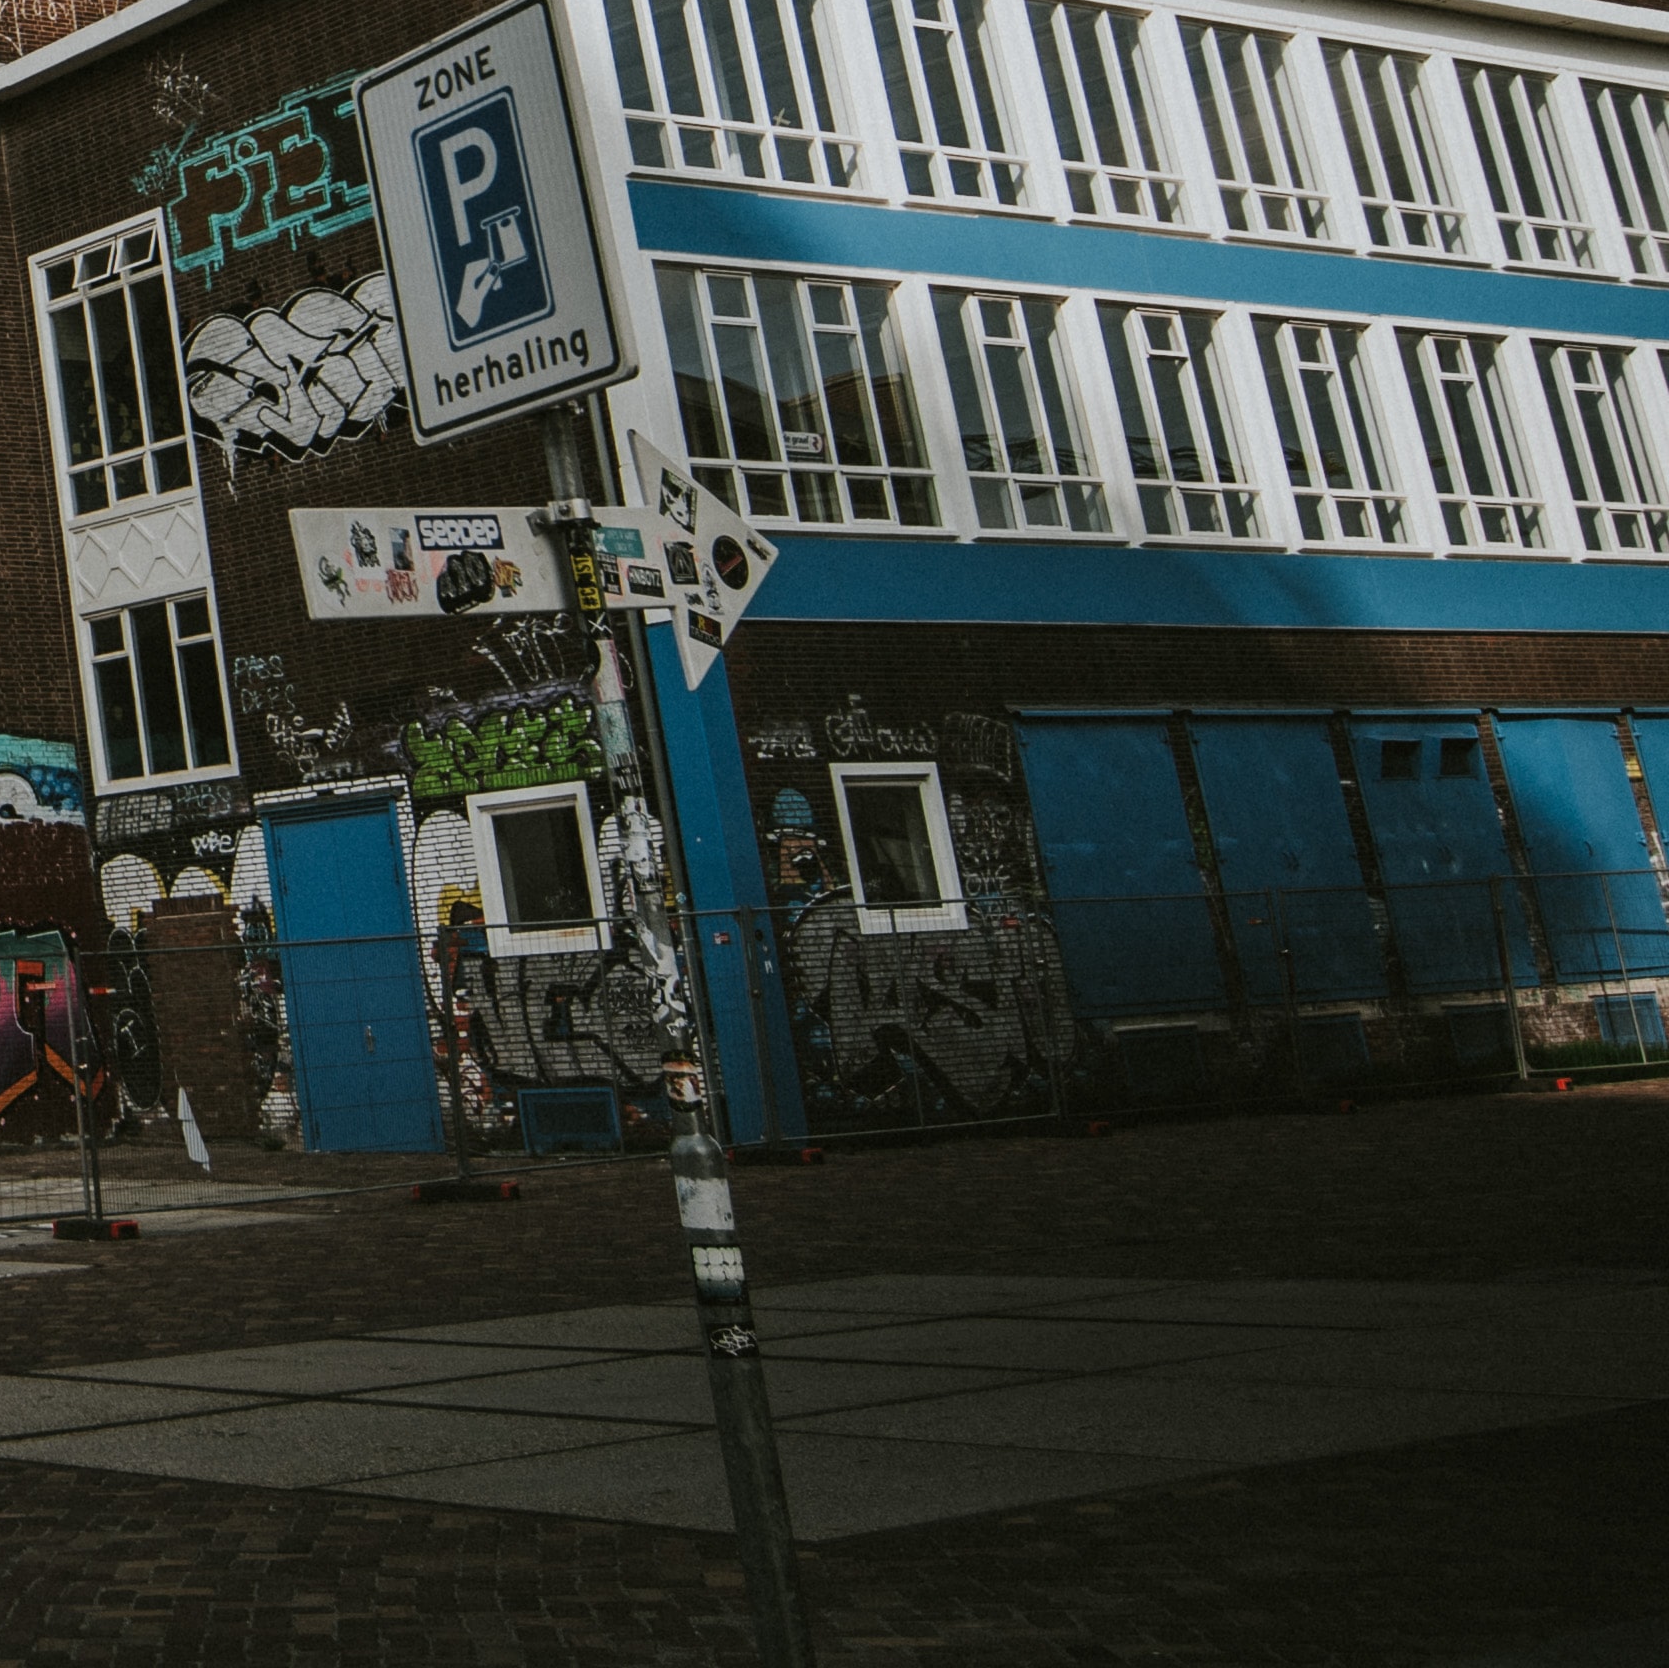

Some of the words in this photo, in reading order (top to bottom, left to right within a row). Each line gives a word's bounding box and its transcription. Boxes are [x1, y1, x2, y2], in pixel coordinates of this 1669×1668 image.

[413, 45, 496, 112] ZONE
[439, 125, 498, 247] P
[432, 328, 590, 408] herhaling
